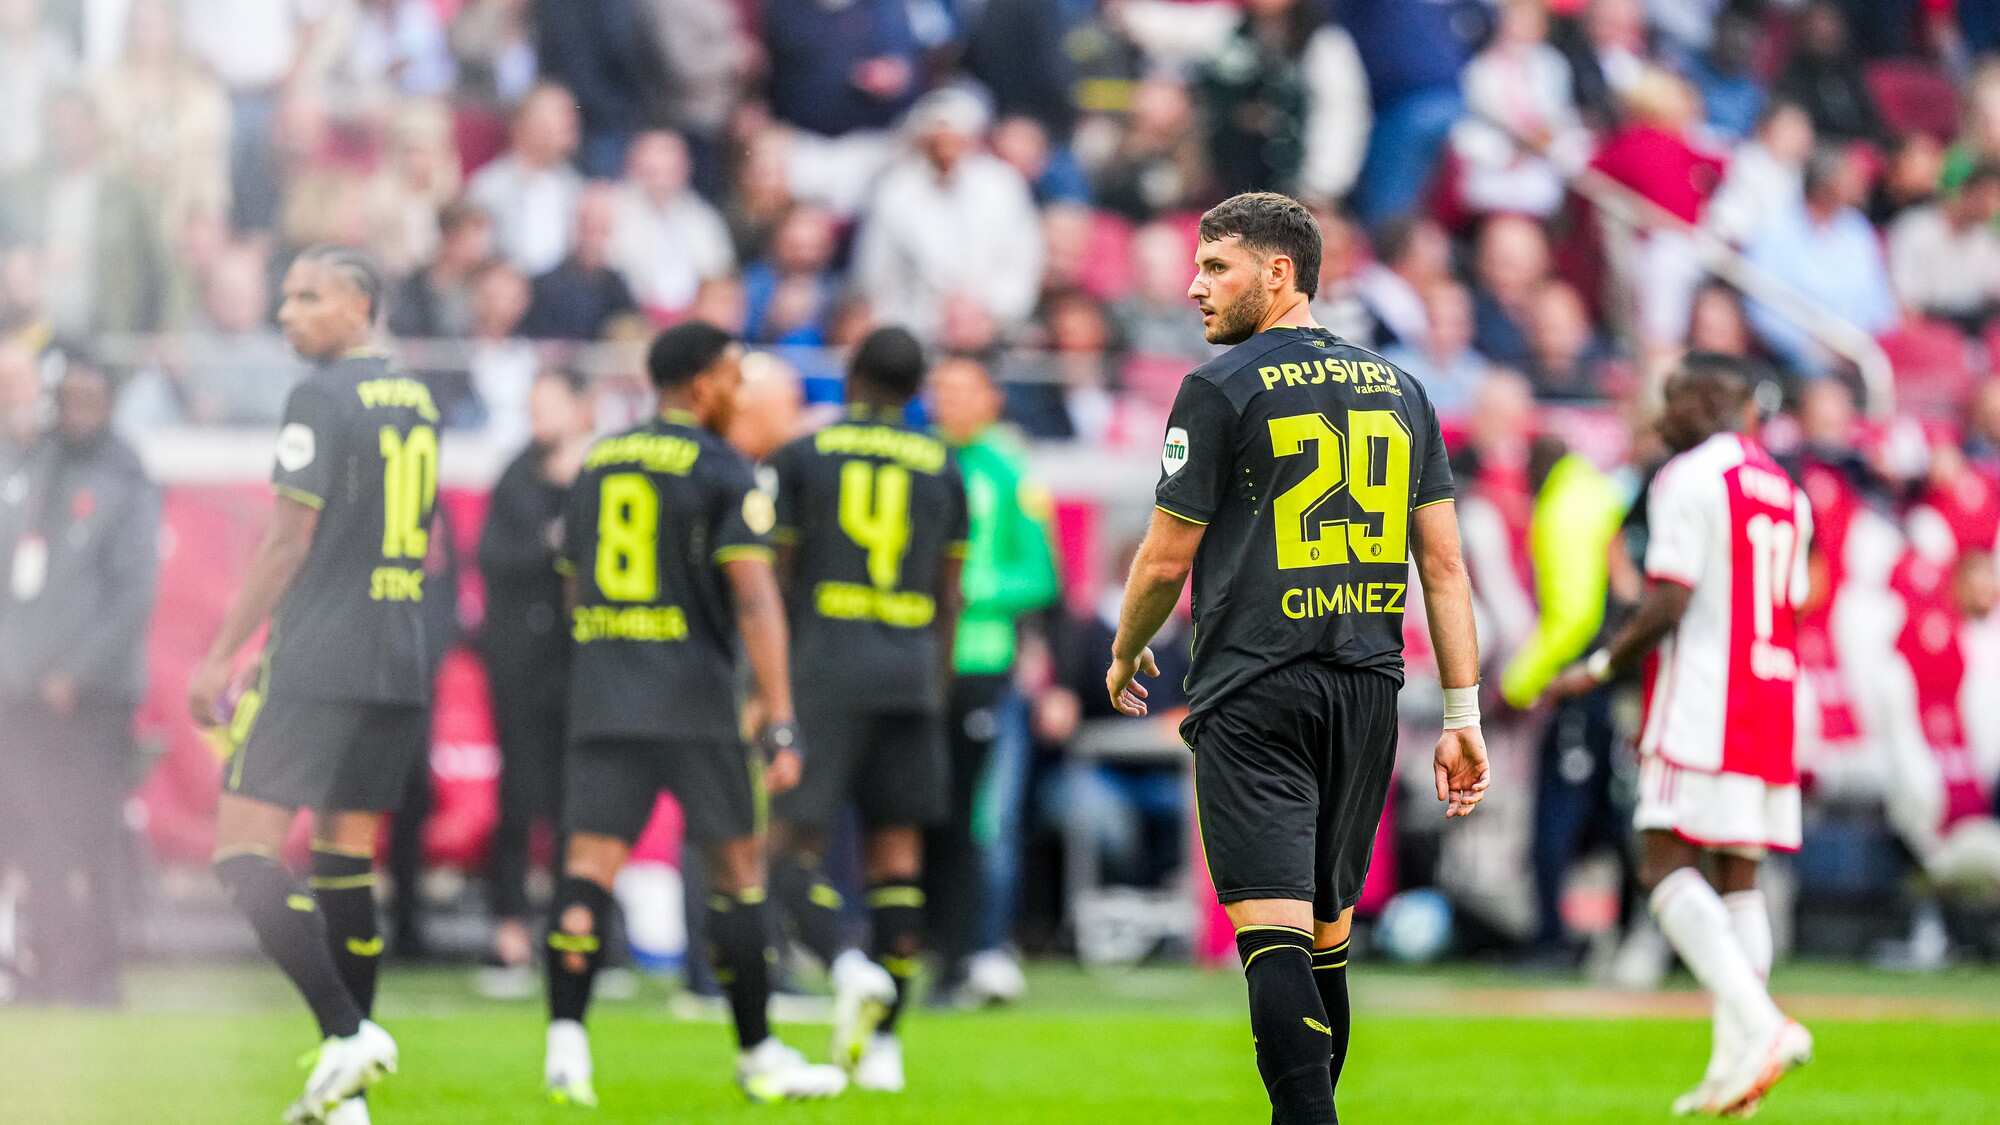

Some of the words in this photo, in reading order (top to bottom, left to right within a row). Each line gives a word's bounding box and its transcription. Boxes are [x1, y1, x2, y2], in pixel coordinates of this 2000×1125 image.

[1165, 443, 1185, 460] TOTO
[1268, 409, 1414, 570] 29
[595, 472, 659, 600] 8
[838, 459, 912, 590] 4
[1281, 582, 1407, 619] GIMNEZ
